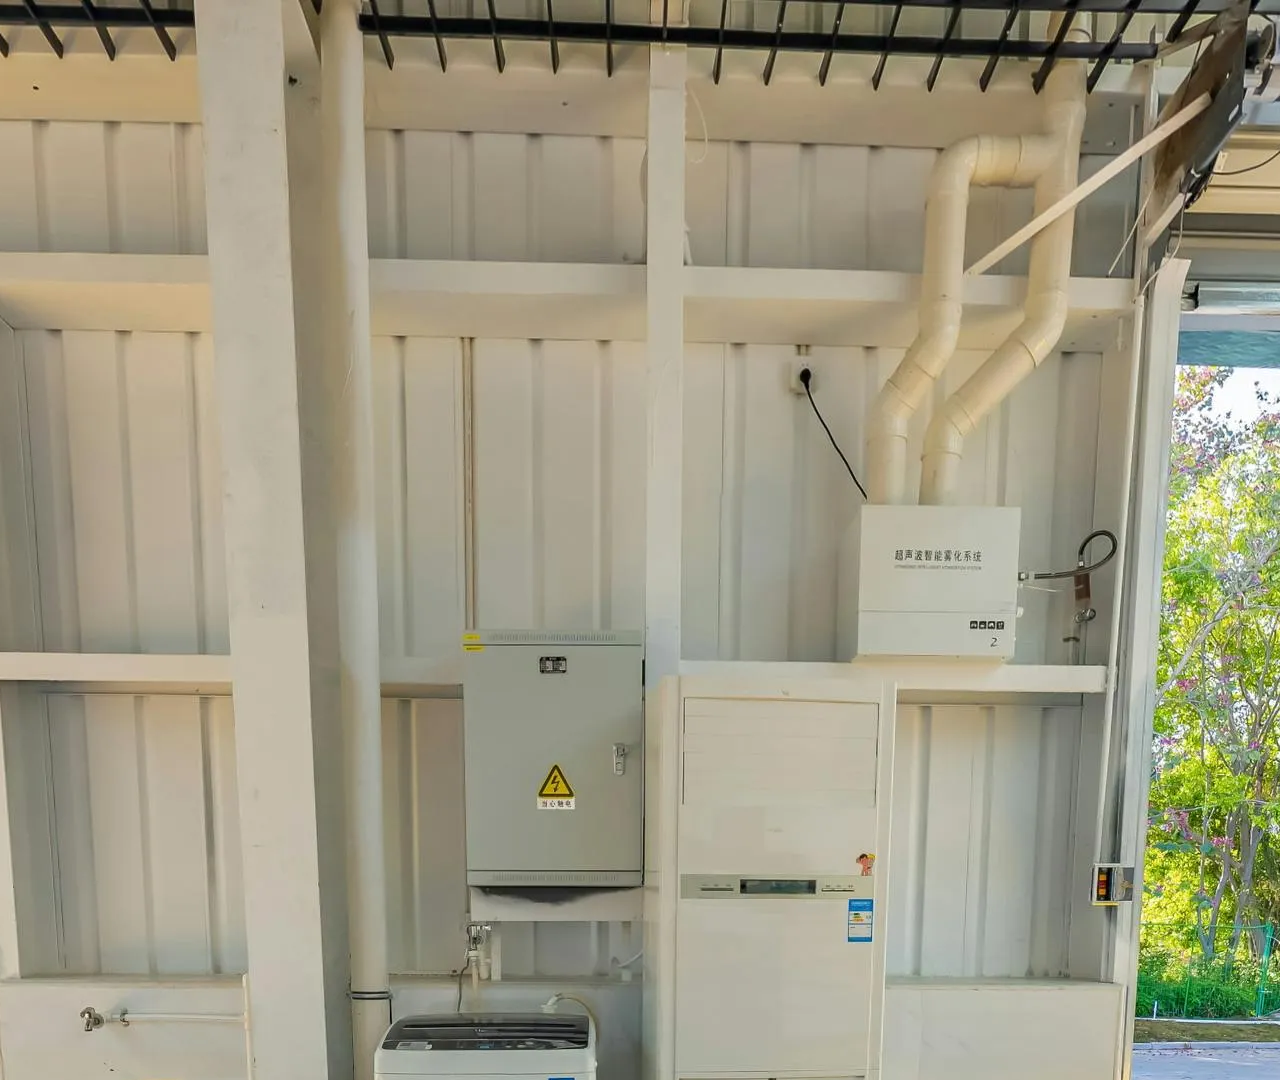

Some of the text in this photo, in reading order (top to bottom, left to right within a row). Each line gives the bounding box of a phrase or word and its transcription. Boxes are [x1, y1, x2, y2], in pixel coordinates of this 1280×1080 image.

[894, 549, 982, 562] 超声波智能雾化系统
[990, 637, 998, 647] 2
